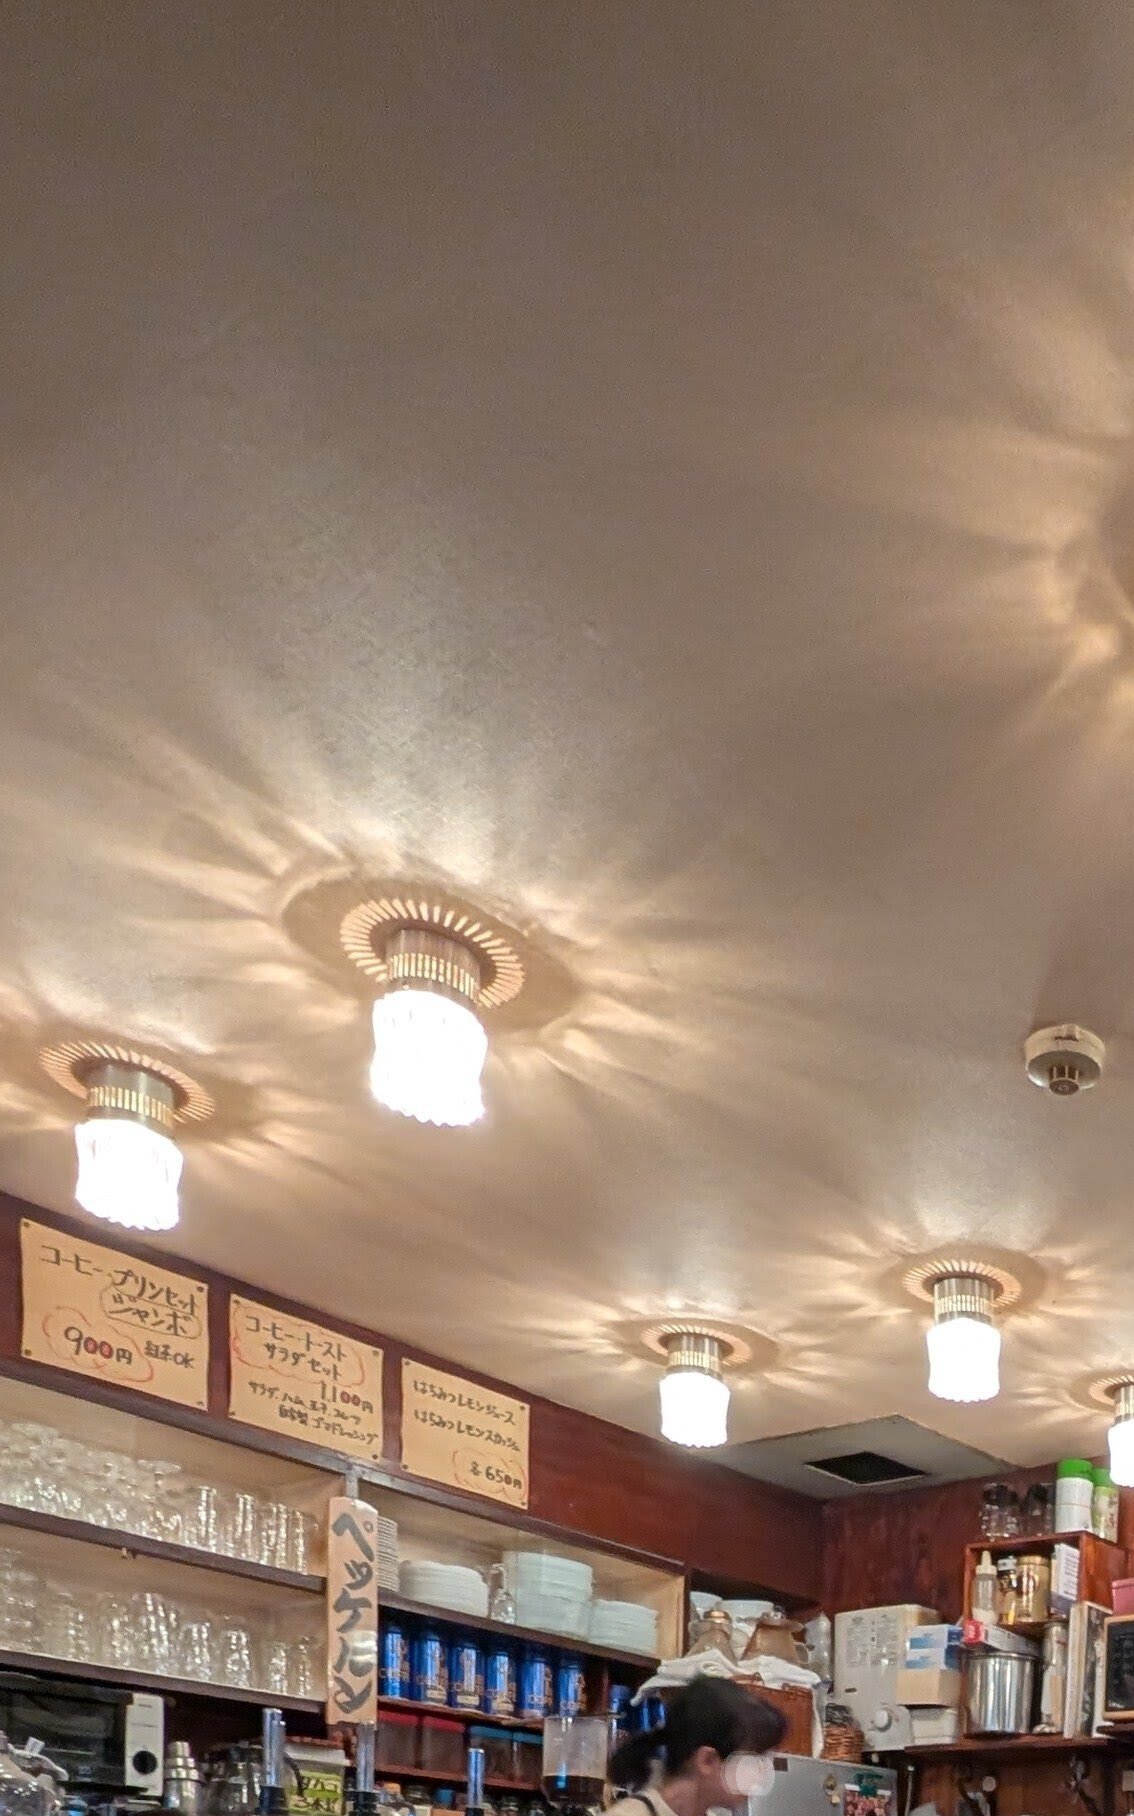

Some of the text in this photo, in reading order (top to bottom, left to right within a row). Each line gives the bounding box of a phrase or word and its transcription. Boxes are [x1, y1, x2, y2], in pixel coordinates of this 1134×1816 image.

[108, 1291, 193, 1336] ジャンボ
[64, 1326, 133, 1365] 900円
[320, 1380, 374, 1414] 1100円
[413, 1379, 516, 1426] はちみつレモンジュース
[413, 1409, 521, 1452] はちみつレモンスカッシュ
